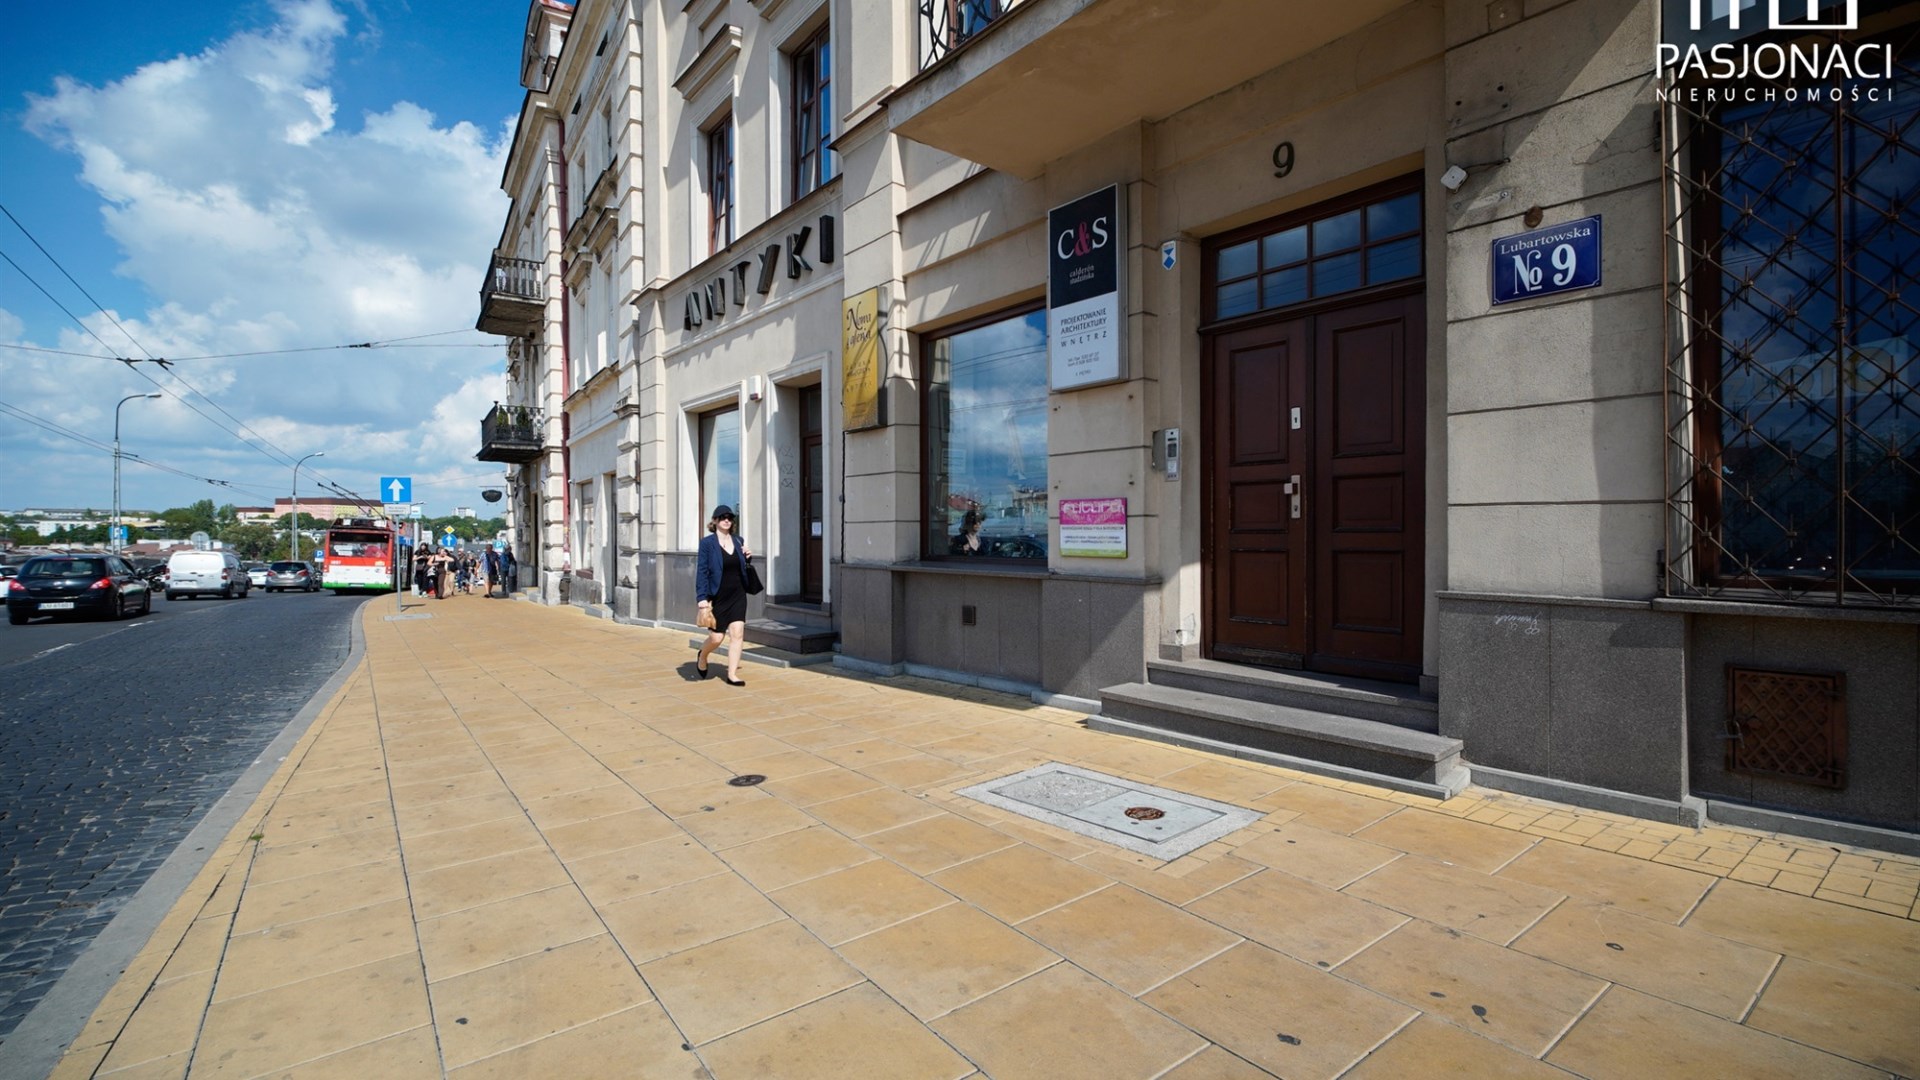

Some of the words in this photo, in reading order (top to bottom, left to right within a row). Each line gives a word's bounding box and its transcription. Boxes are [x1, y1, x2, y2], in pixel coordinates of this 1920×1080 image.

[1272, 141, 1295, 178] 9
[1057, 216, 1109, 260] C&S
[1501, 227, 1591, 255] Lubartowska
[683, 214, 835, 331] ANTYKI
[1551, 243, 1577, 286] 9
[1061, 308, 1106, 326] PROJEKTOWANIE
[1061, 317, 1107, 335] ARCHITEKTURY
